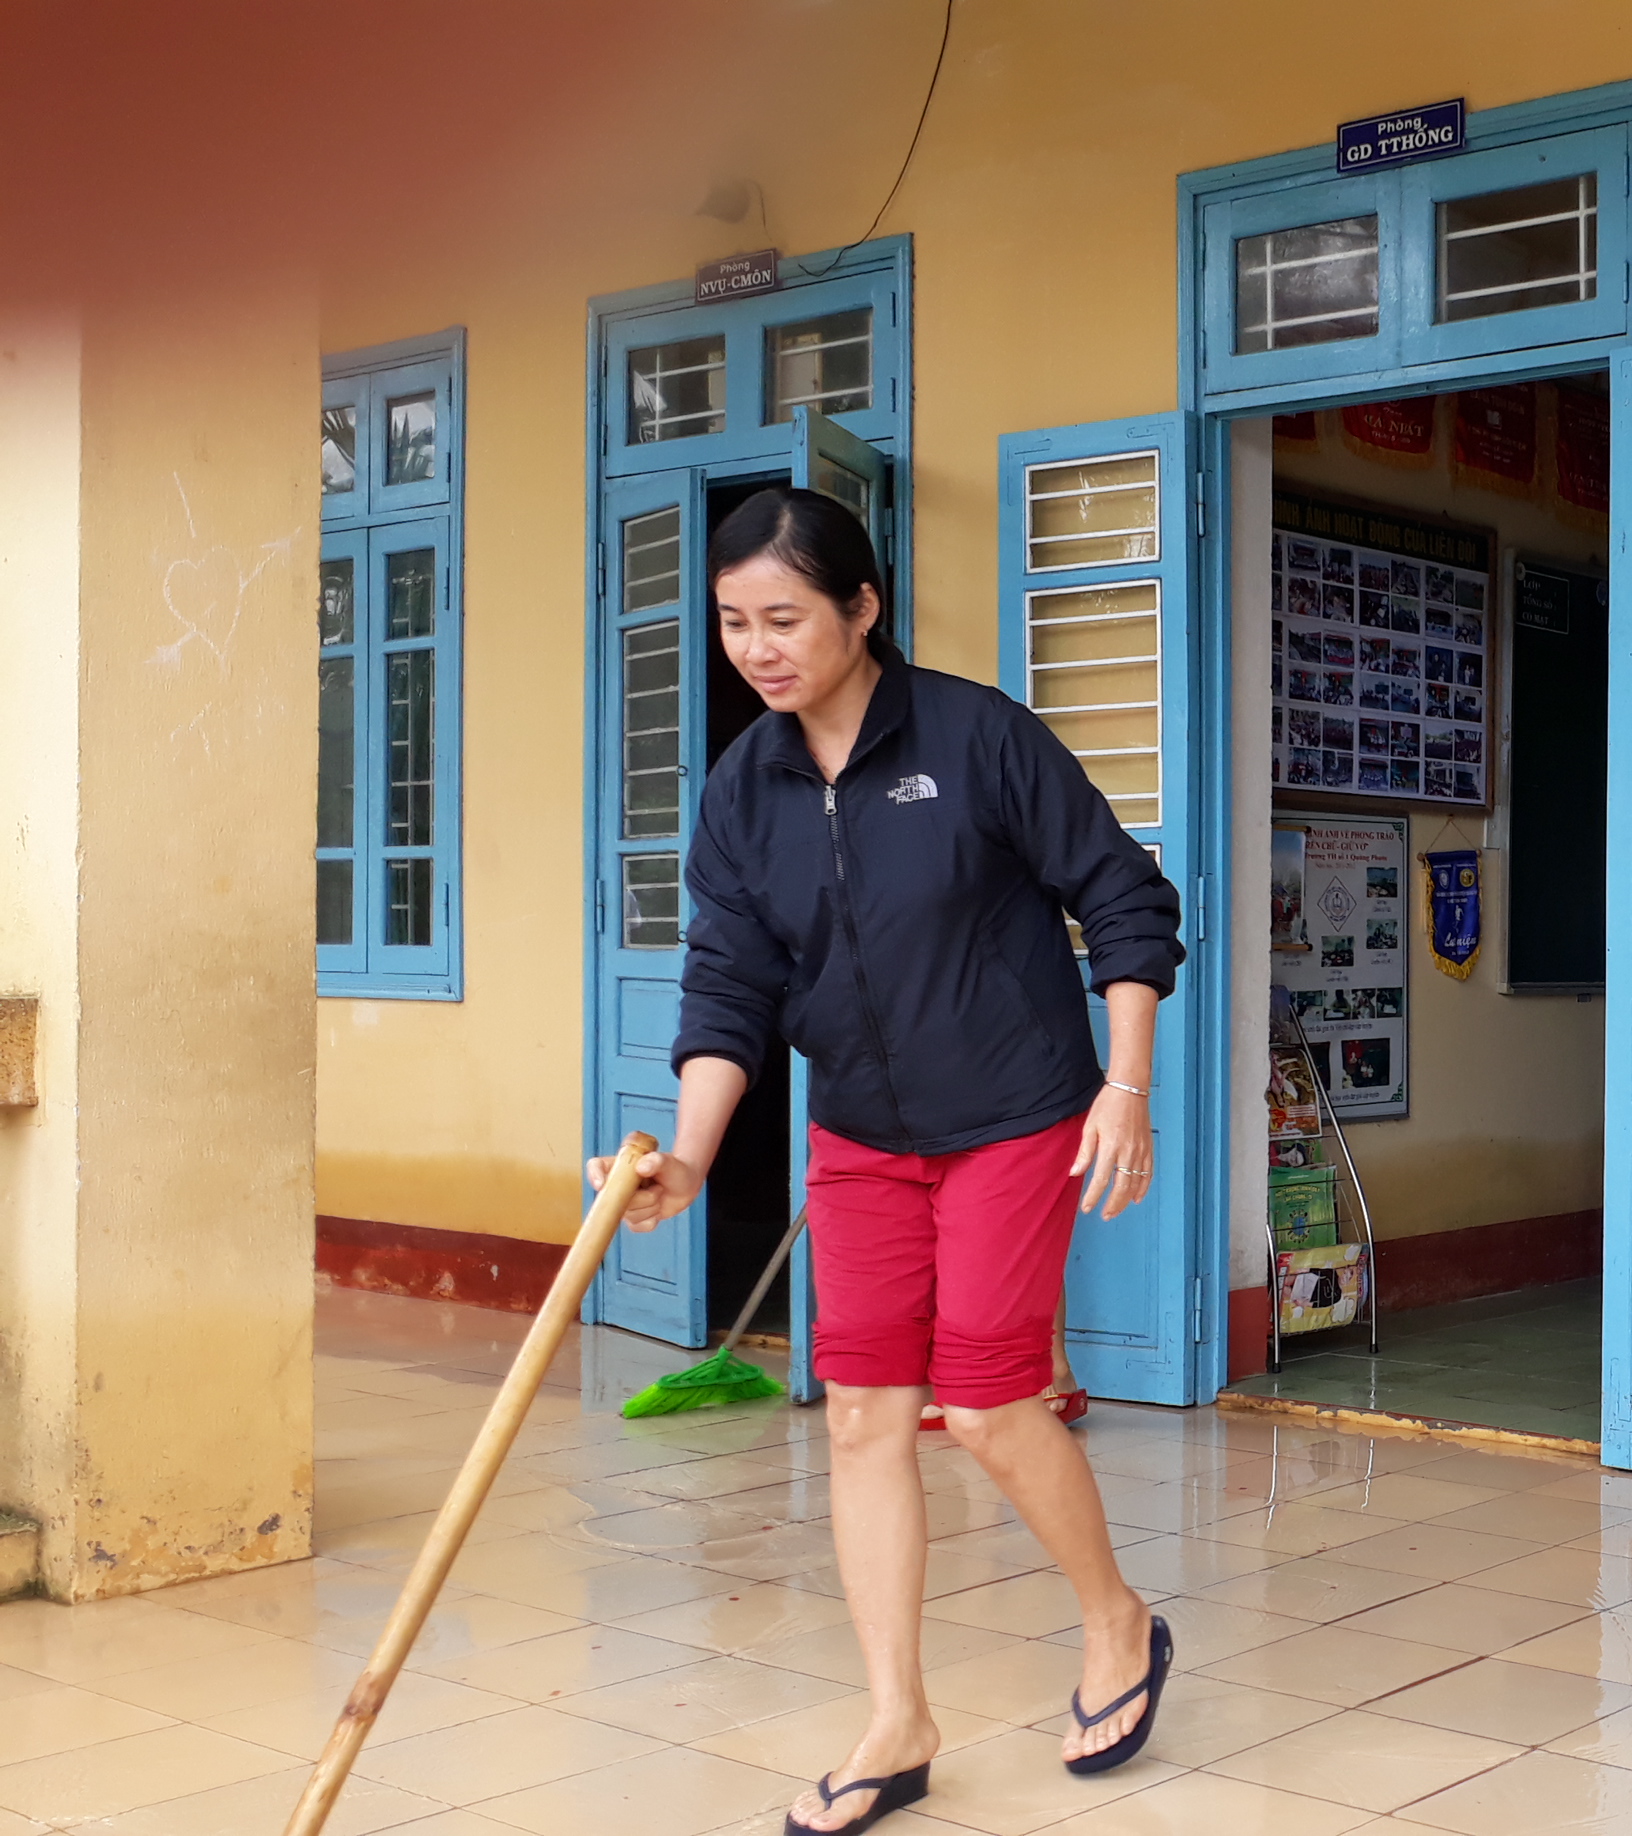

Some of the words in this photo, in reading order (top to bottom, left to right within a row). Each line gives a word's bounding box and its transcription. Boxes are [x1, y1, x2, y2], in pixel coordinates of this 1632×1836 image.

[1377, 117, 1422, 136] Phòng
[1346, 143, 1373, 162] GD
[1378, 124, 1454, 156] TTHỐNG
[720, 262, 750, 274] Phòng
[1333, 511, 1364, 543] HOẠT
[1429, 531, 1455, 560] LIÊN
[899, 776, 918, 787] THE
[887, 784, 919, 799] NORTH
[896, 792, 920, 805] FACE
